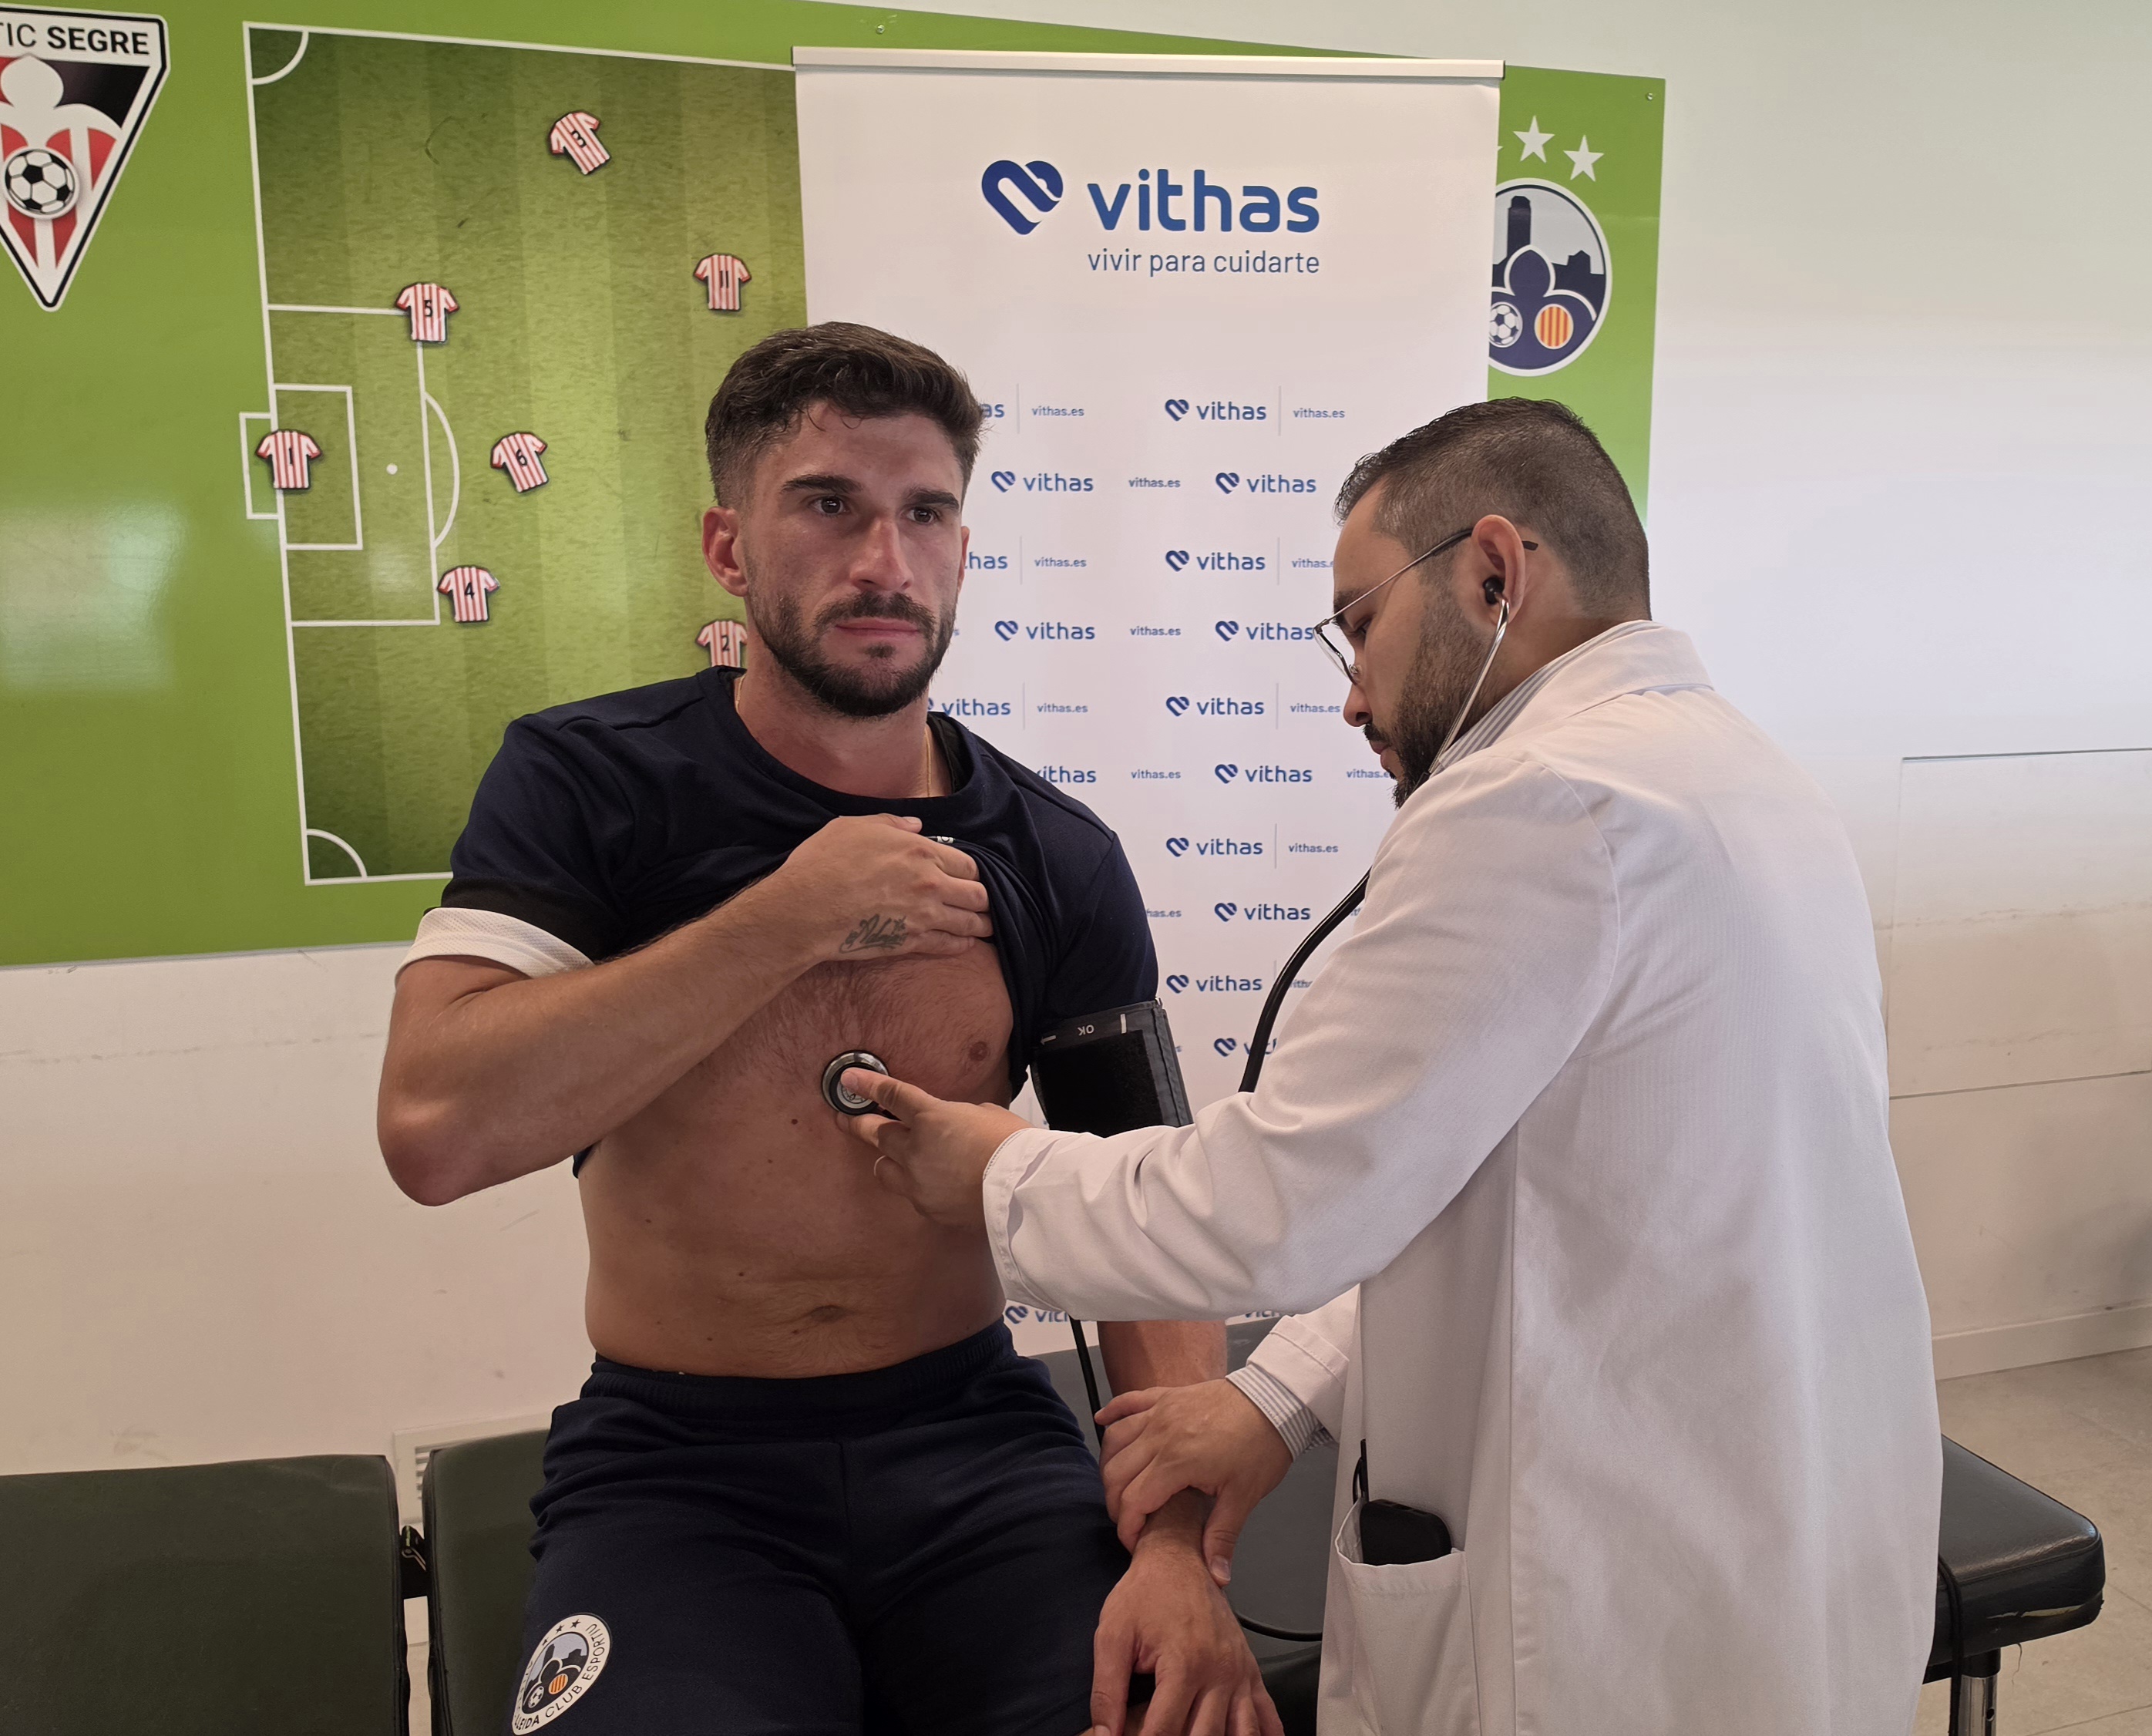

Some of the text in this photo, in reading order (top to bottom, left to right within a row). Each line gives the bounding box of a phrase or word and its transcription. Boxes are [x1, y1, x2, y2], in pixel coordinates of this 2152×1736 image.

[47, 25, 150, 56] SEGRE
[571, 130, 587, 149] 3
[1087, 168, 1320, 233] vithas
[1088, 247, 1320, 278] vivir para cuidarte
[720, 270, 730, 290] 11
[423, 299, 433, 318] 5
[1031, 405, 1084, 417] vithas.es
[1196, 401, 1345, 420] vithas vithas.es
[287, 446, 294, 465] 1
[516, 448, 528, 468] 6
[1023, 473, 1094, 492] vithas
[1128, 476, 1181, 488] vithas.es
[1246, 474, 1316, 493] vithas
[965, 551, 1088, 570] has vithas.es
[1196, 552, 1266, 570] vithas
[464, 582, 476, 601] 4
[1025, 621, 1095, 640] vithas
[1130, 625, 1182, 636] vithas.es
[1246, 622, 1314, 641] vithas
[721, 634, 730, 652] 2
[941, 698, 1088, 716] vithas vithas.es
[1196, 697, 1341, 715] vithas vithas.es
[1131, 769, 1182, 779] vithas.es
[1245, 765, 1313, 782] vithas
[1346, 769, 1389, 779] vithas.e
[1196, 838, 1339, 856] vithas vithas.es
[1244, 903, 1311, 920] vithas
[1195, 975, 1263, 992] vithas
[1077, 1024, 1094, 1036] OK
[545, 1685, 583, 1718] CLUB
[582, 1623, 606, 1681] ESPORTIU
